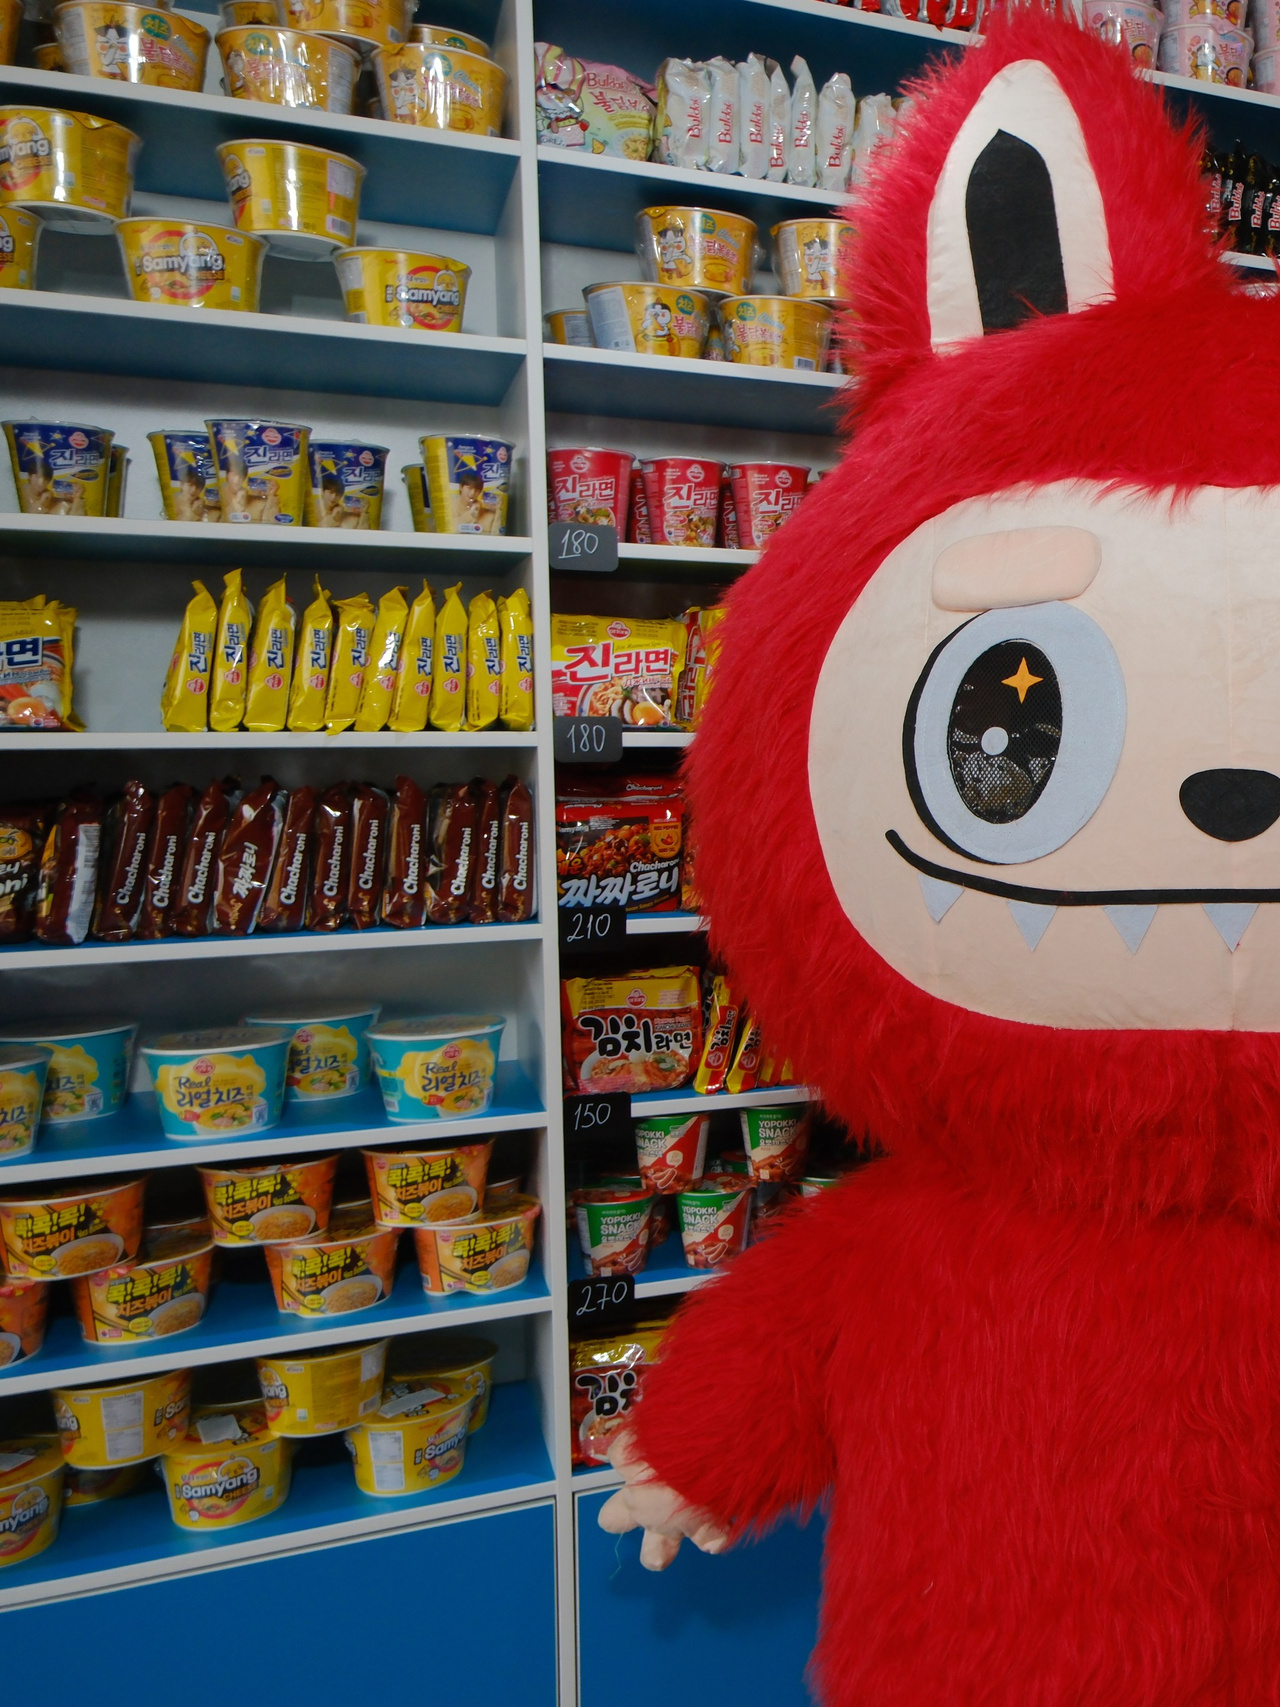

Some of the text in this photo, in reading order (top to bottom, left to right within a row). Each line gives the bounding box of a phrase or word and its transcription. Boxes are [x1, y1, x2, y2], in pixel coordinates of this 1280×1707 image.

[718, 102, 733, 144] Buldak
[749, 103, 763, 144] Buldak
[829, 125, 846, 168] Buldak
[142, 253, 225, 275] Samyang
[394, 284, 461, 306] Samyang
[50, 448, 100, 468] 진라면
[243, 446, 294, 467] 진라면
[555, 474, 616, 506] 진라면
[558, 529, 599, 559] 180
[188, 632, 209, 673] 진라면
[267, 628, 286, 670] 진라면
[310, 629, 328, 670] 진라면
[351, 627, 369, 668] 진라면
[417, 636, 433, 676] 진라면
[443, 634, 461, 674] 진라면
[517, 634, 532, 673] 진라면
[564, 641, 672, 685] 진라면
[567, 723, 606, 753] 180
[116, 833, 147, 905] Chacharoni
[152, 835, 177, 908] Chacharoni
[187, 831, 216, 905] Chacharoni
[279, 833, 307, 906] Chacharoni
[323, 825, 344, 897] Chacharoni
[358, 819, 379, 890] Chacharoni
[402, 823, 421, 895] Chacharoni
[450, 827, 472, 896] Chacharoni
[481, 820, 499, 889] Chacharoni
[513, 821, 529, 890] Chacharoni
[557, 866, 679, 907] 짜짜로니
[567, 912, 611, 943] 210
[579, 1014, 694, 1059] 김치라면
[174, 1075, 211, 1089] Real
[421, 1060, 458, 1076] Real
[574, 1102, 611, 1131] 150
[758, 1118, 797, 1129] YOPOKKI
[758, 1128, 798, 1139] SNACK
[601, 1212, 641, 1224] YOPOKKI
[601, 1221, 641, 1235] SNACK
[683, 1213, 718, 1224] SNACK
[576, 1281, 628, 1316] 270
[182, 1468, 259, 1499] Samyang
